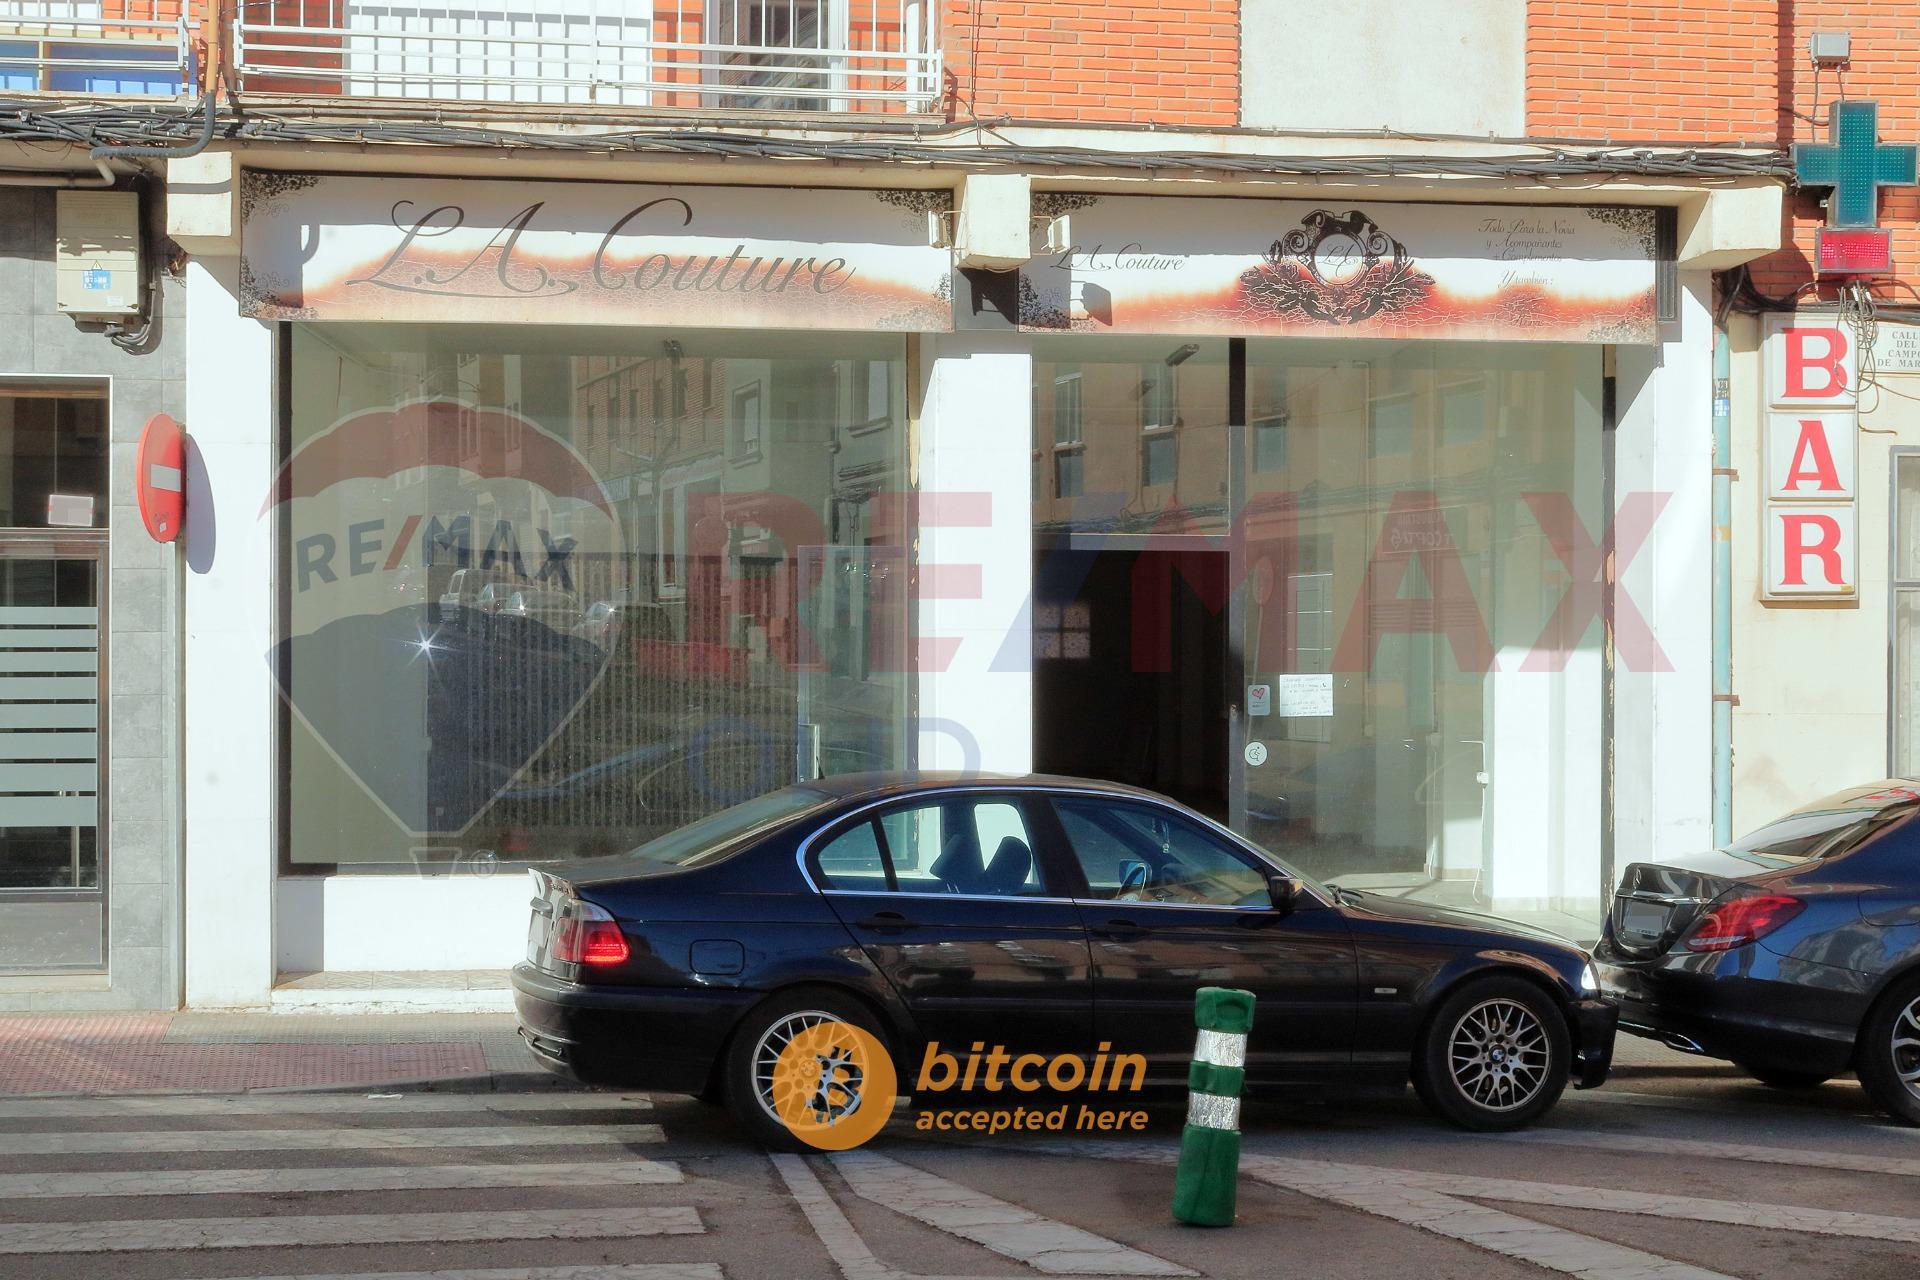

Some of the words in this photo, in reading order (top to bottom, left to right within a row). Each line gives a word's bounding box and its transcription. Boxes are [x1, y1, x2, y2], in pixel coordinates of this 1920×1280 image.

[1477, 218, 1504, 233] Todo
[1507, 219, 1534, 234] Para
[1546, 219, 1575, 234] Novia
[593, 197, 856, 294] Couture
[1115, 242, 1185, 270] Couture
[1896, 340, 1917, 349] DEL
[1877, 358, 1892, 367] DE
[1781, 326, 1848, 586] BAR
